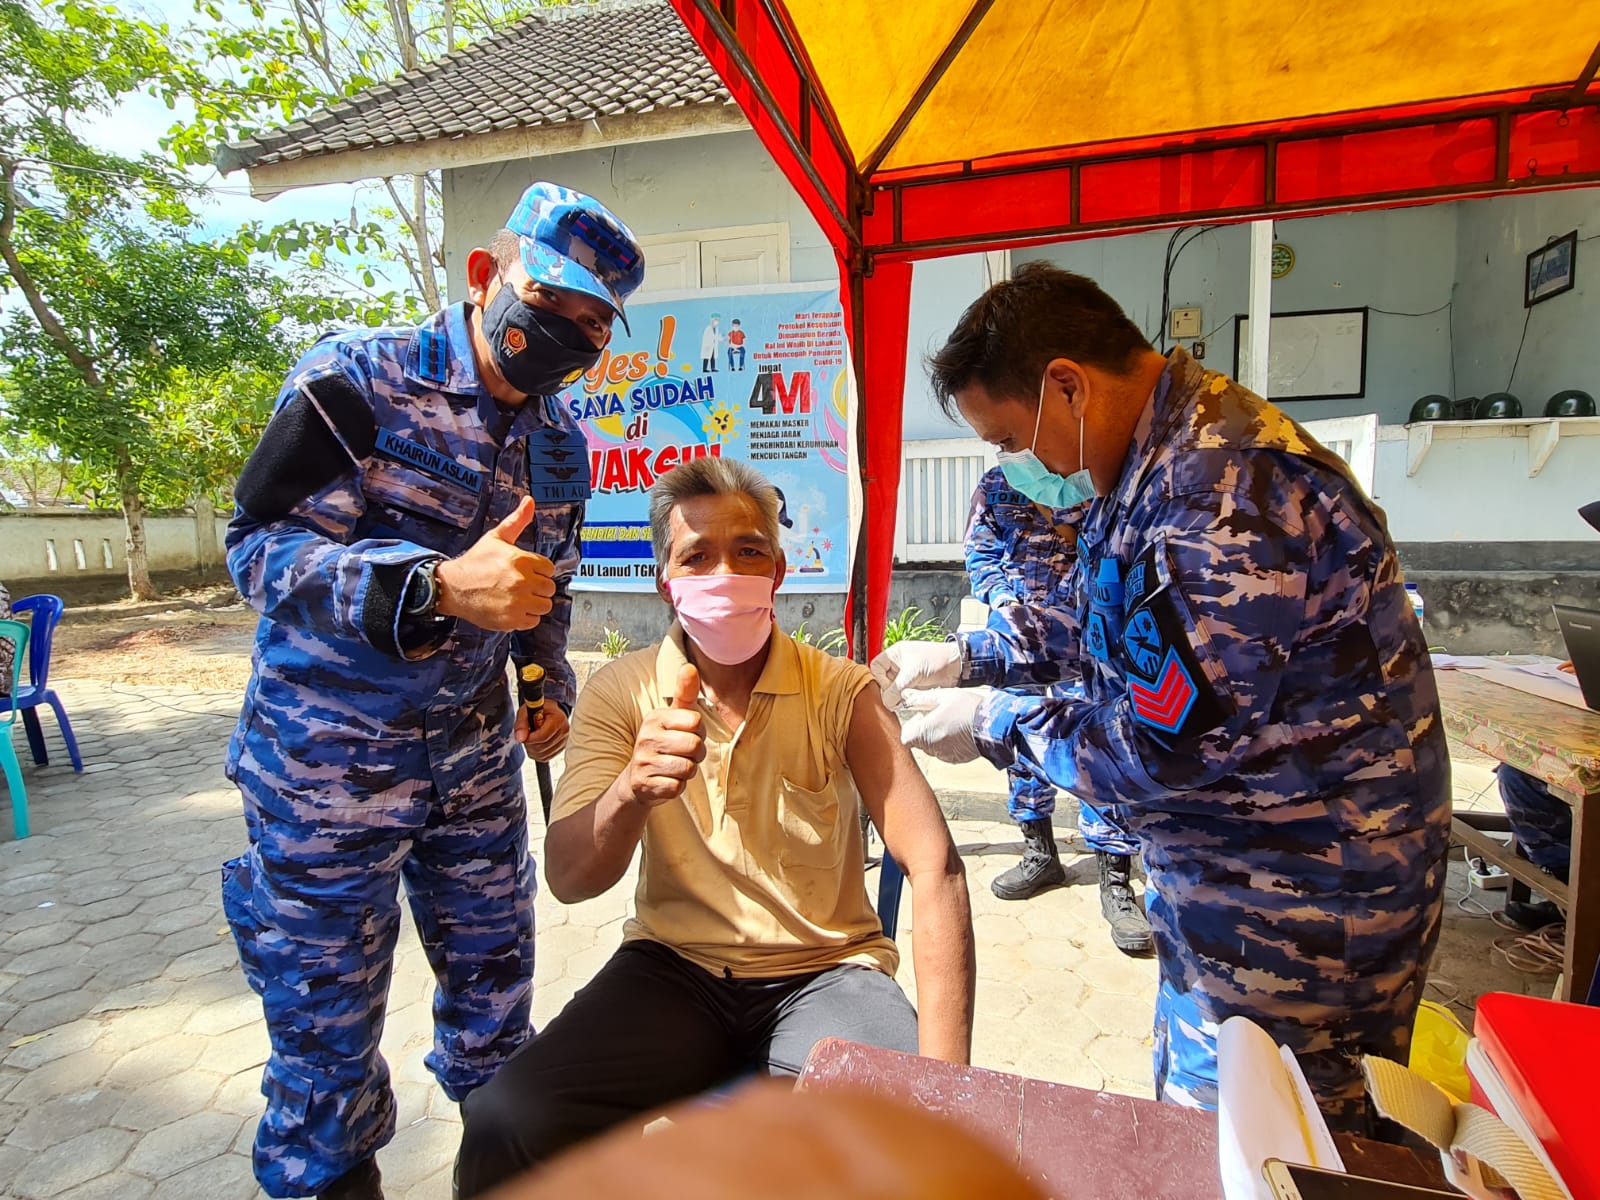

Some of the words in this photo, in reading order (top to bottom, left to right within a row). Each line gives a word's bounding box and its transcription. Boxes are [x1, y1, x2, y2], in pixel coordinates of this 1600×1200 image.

[778, 322, 806, 330] Protokol
[807, 321, 842, 329] Kesehatan
[753, 352, 772, 360] Untuk
[758, 363, 782, 375] Ingat
[569, 392, 625, 421] SAYA
[630, 375, 715, 411] SUDAH
[749, 371, 811, 415] 4M
[625, 411, 649, 441] di
[750, 420, 781, 429] MEMAKAI
[782, 419, 809, 428] MASKER
[750, 431, 780, 440] MENJAGA
[781, 430, 802, 438] JARAK
[750, 441, 796, 450] MENGHINDARI
[797, 440, 839, 449] KERUMUNAN
[384, 434, 440, 472] KHAIRUN
[750, 452, 780, 461] MENCUCI
[781, 451, 808, 460] TANGAN
[543, 485, 566, 498] TNI
[571, 485, 584, 498] AU
[580, 564, 595, 577] AU
[597, 563, 631, 577] Lanud
